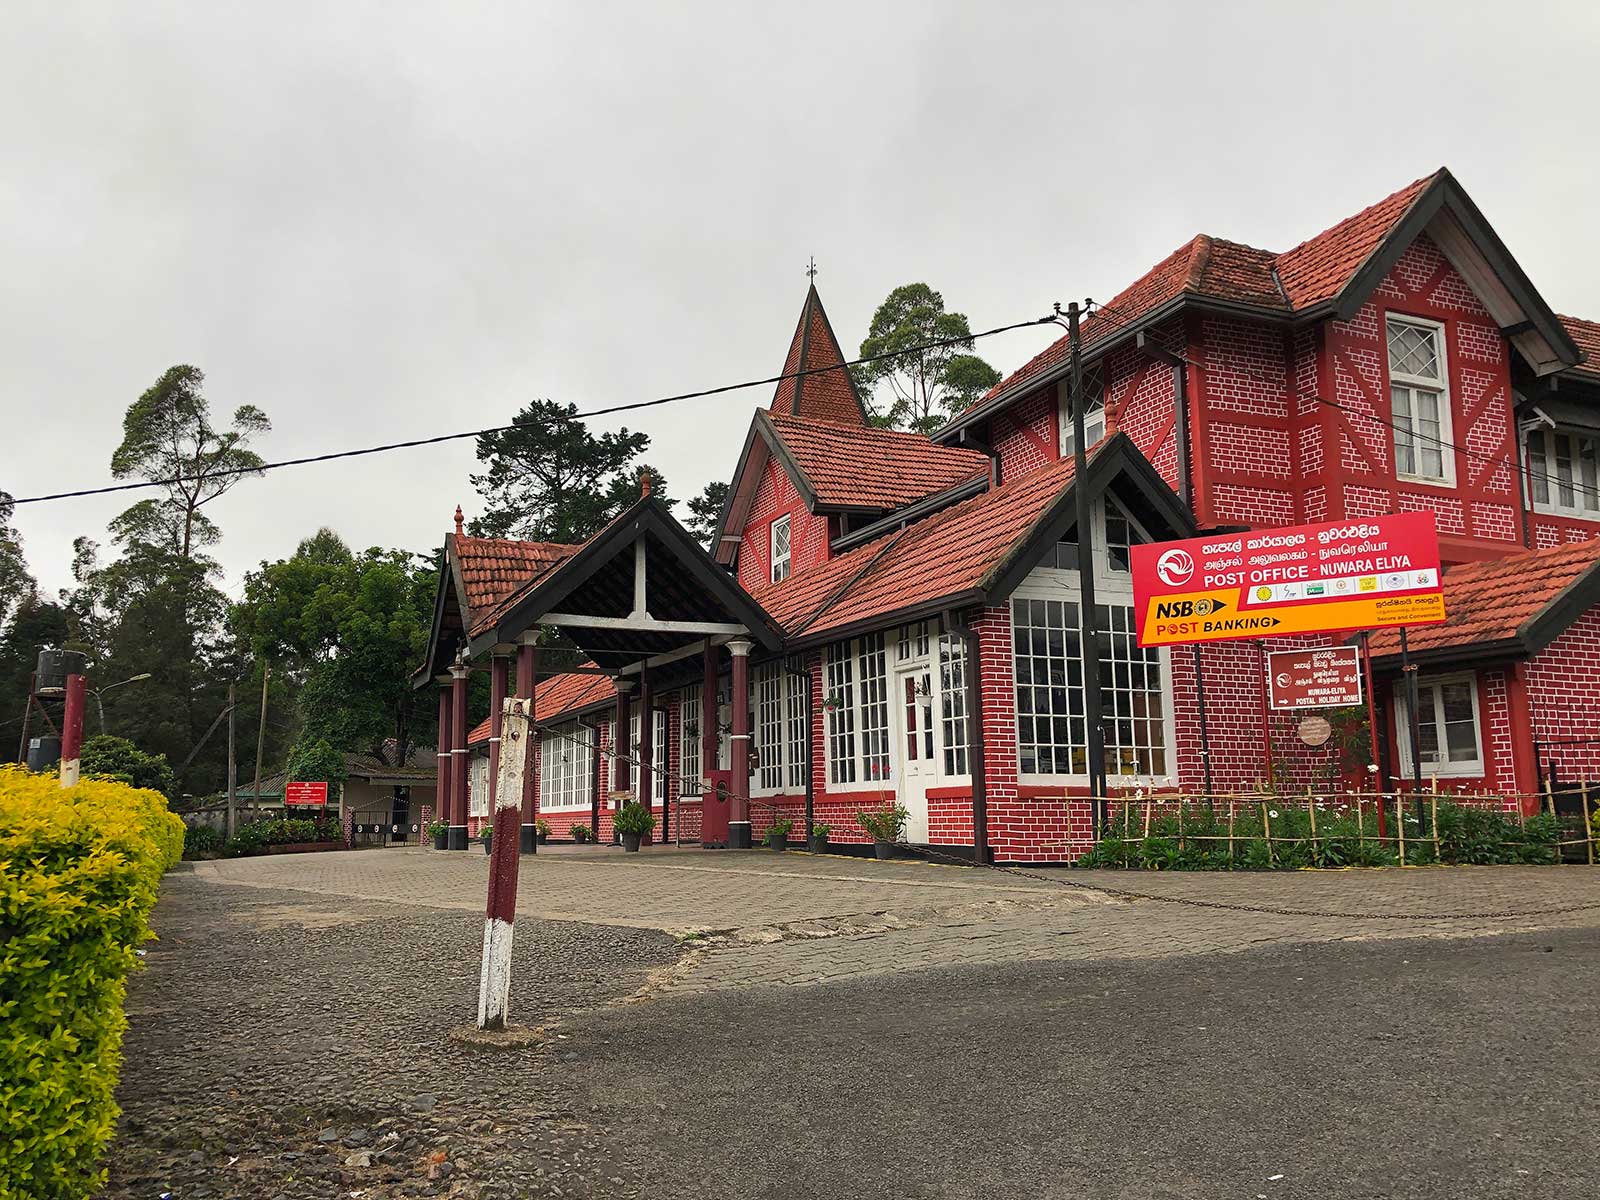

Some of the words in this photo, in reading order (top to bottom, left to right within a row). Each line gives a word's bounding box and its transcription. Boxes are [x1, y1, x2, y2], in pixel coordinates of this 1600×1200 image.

[1202, 539, 1242, 554] තැපැල්
[1247, 532, 1305, 549] කාර්යාලය
[1203, 556, 1243, 571] அஞ்சல்
[1248, 549, 1307, 565] அலுவலகம்
[1319, 541, 1388, 560] நுவரெலியா
[1204, 571, 1246, 587] POST
[1250, 566, 1308, 583] OFFICE
[1320, 559, 1373, 576] NUWARA
[1376, 555, 1411, 570] ELIYA
[1156, 601, 1193, 619] NSB
[1157, 622, 1198, 635] POST
[1204, 617, 1270, 632] BANKING
[1308, 687, 1346, 696] NUWARA-ELIYA
[1296, 697, 1315, 705] POSTAL
